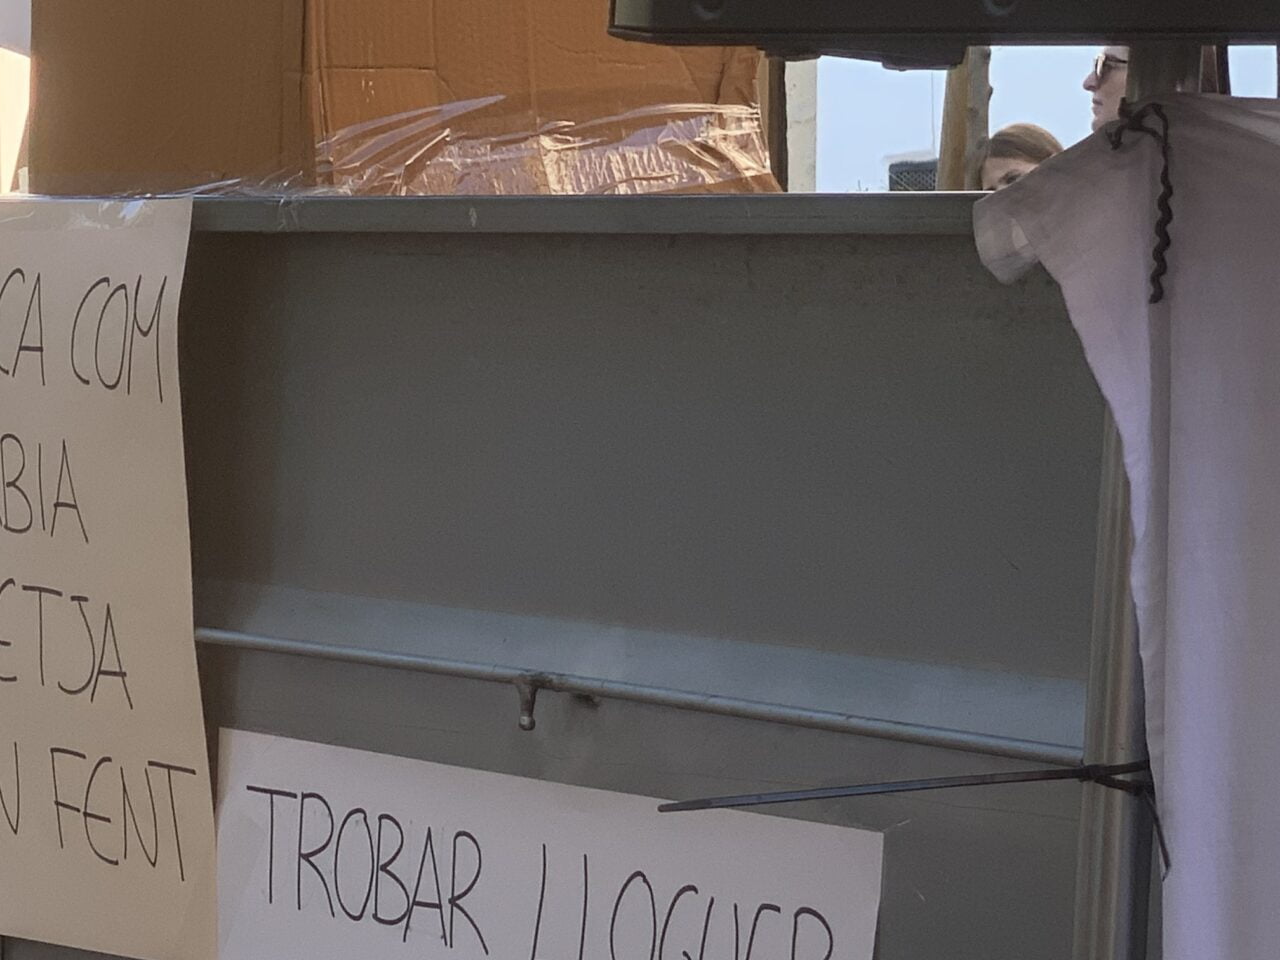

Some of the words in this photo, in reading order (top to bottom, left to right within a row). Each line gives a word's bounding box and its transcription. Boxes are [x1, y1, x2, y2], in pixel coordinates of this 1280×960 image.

[70, 274, 168, 404] COM
[49, 746, 197, 882] FENT
[246, 784, 490, 956] TROBAR
